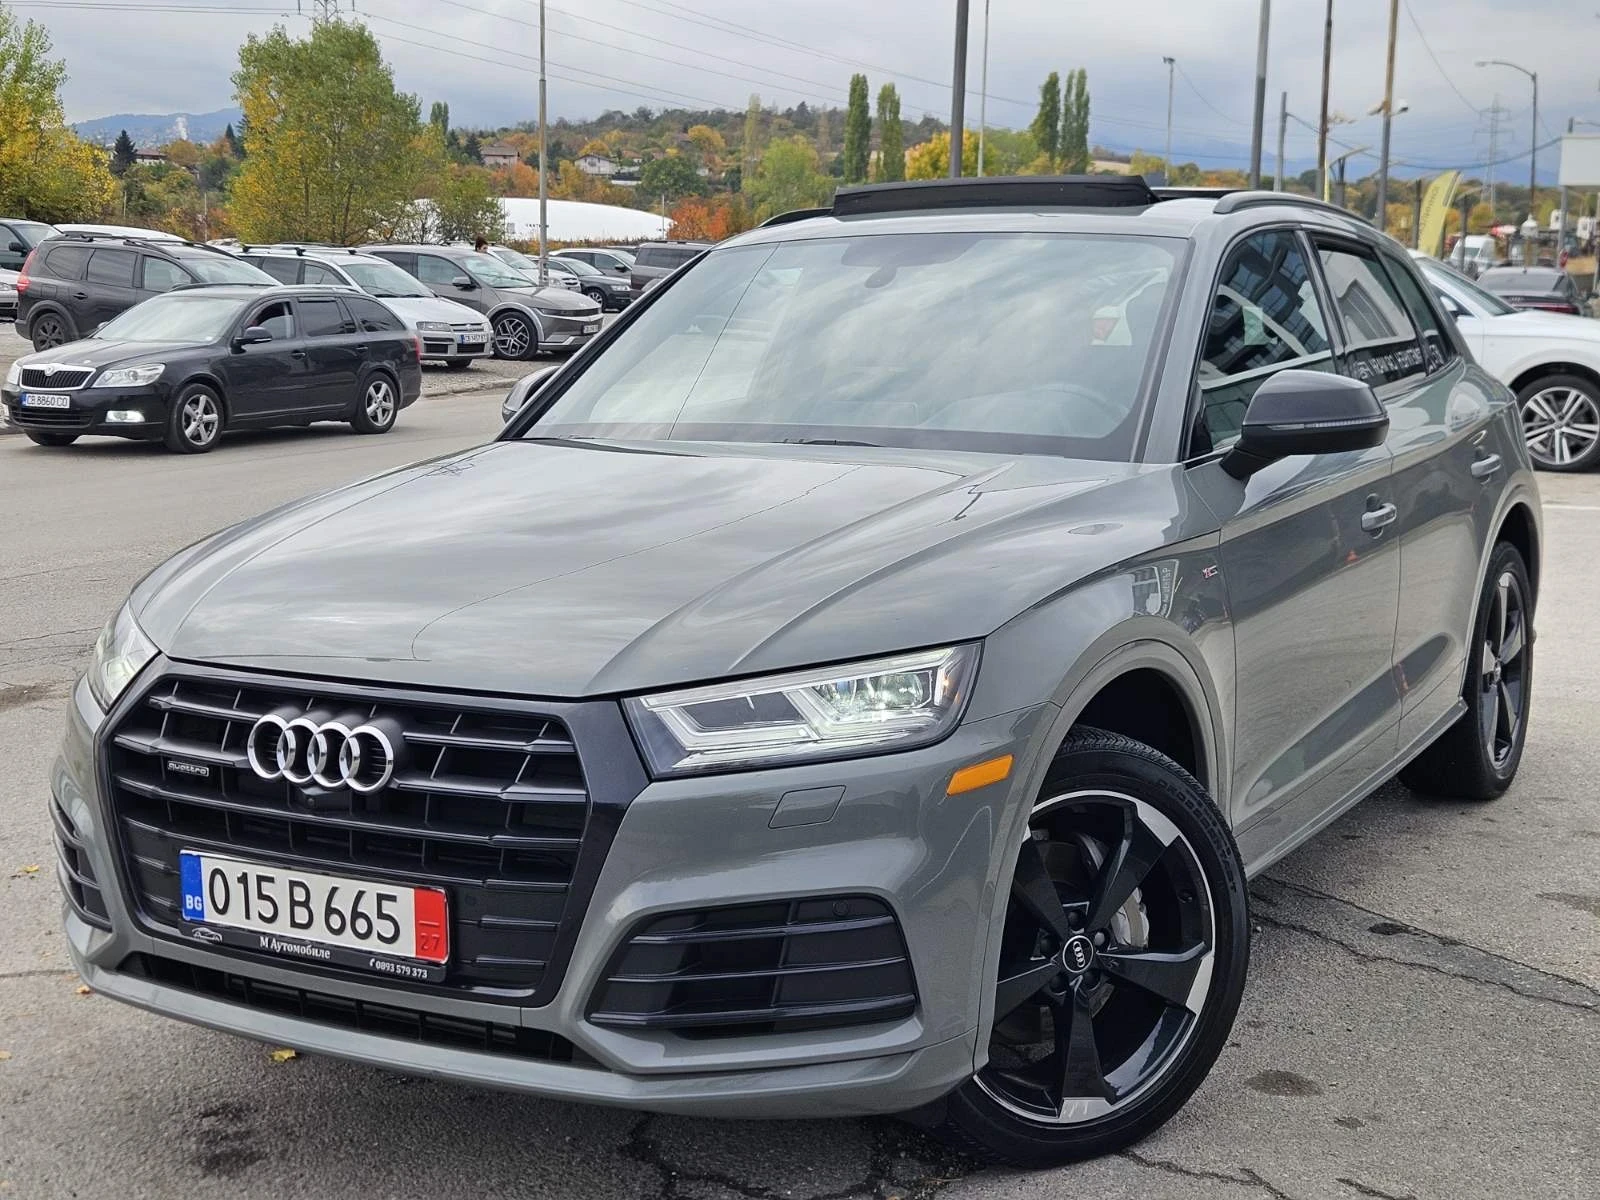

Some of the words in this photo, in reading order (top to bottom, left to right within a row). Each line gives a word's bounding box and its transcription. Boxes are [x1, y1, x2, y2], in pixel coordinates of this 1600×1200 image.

[168, 762, 207, 775] quattro
[185, 894, 203, 911] BG
[420, 933, 440, 951] 27
[375, 960, 395, 973] 0893
[396, 964, 411, 976] 579
[412, 967, 428, 979] 373
